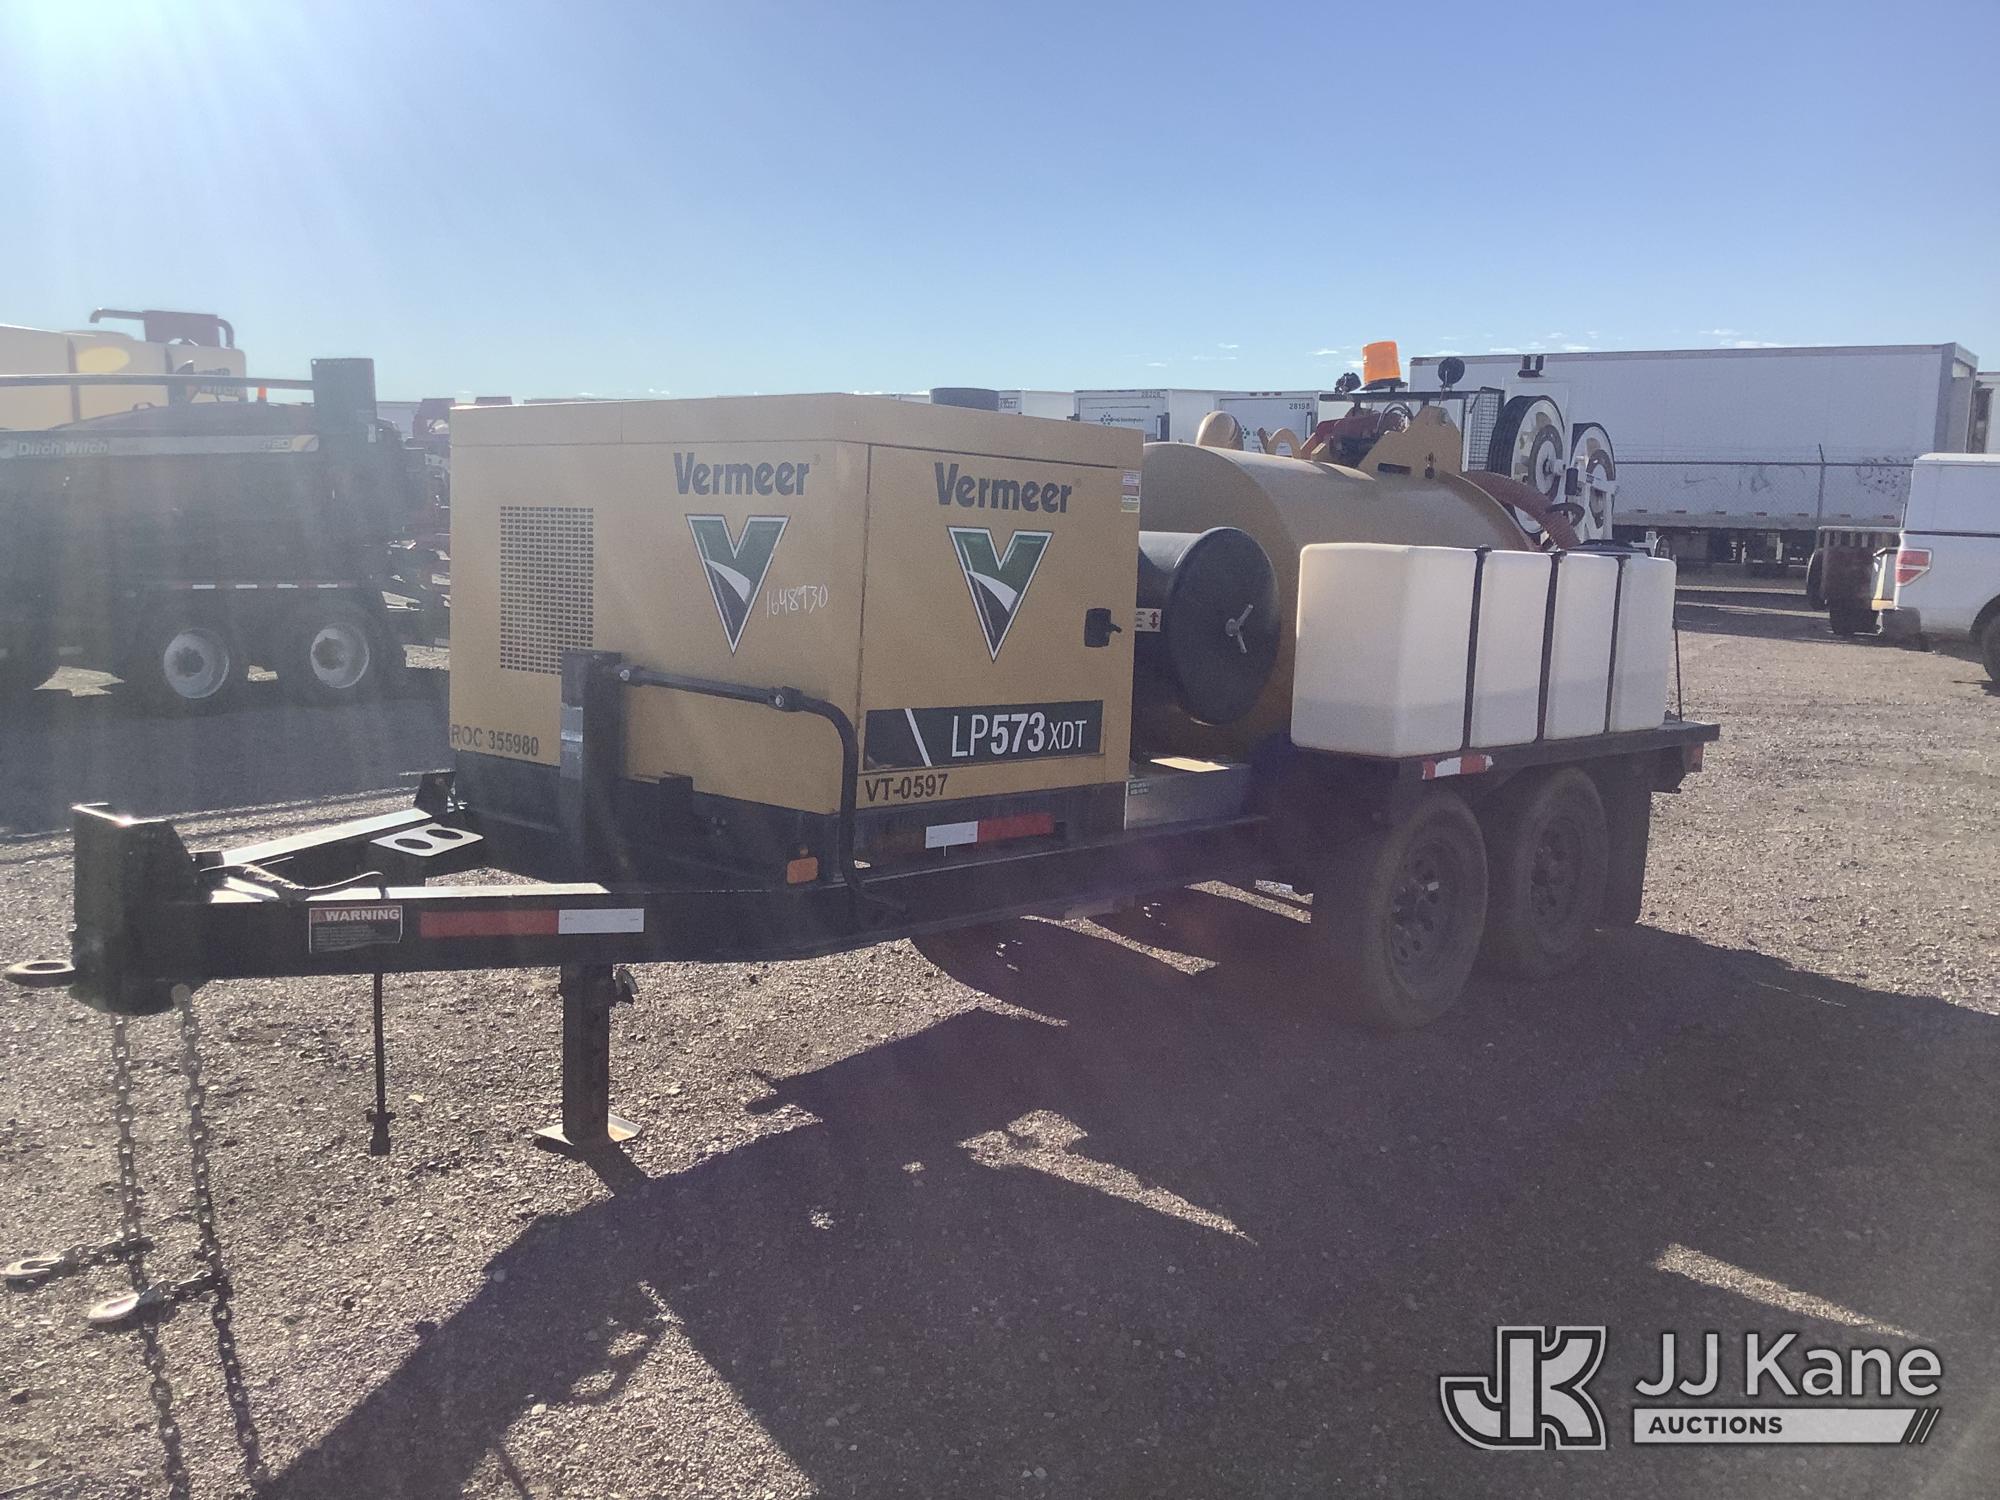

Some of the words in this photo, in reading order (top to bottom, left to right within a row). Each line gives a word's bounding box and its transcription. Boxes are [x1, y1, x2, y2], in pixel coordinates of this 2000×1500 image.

[673, 452, 810, 496] Vermeer
[934, 461, 1073, 513] Vermeer
[450, 724, 483, 748] ROC
[487, 730, 540, 757] 355980
[865, 773, 949, 802] VT-0597
[325, 909, 400, 921] WARNING
